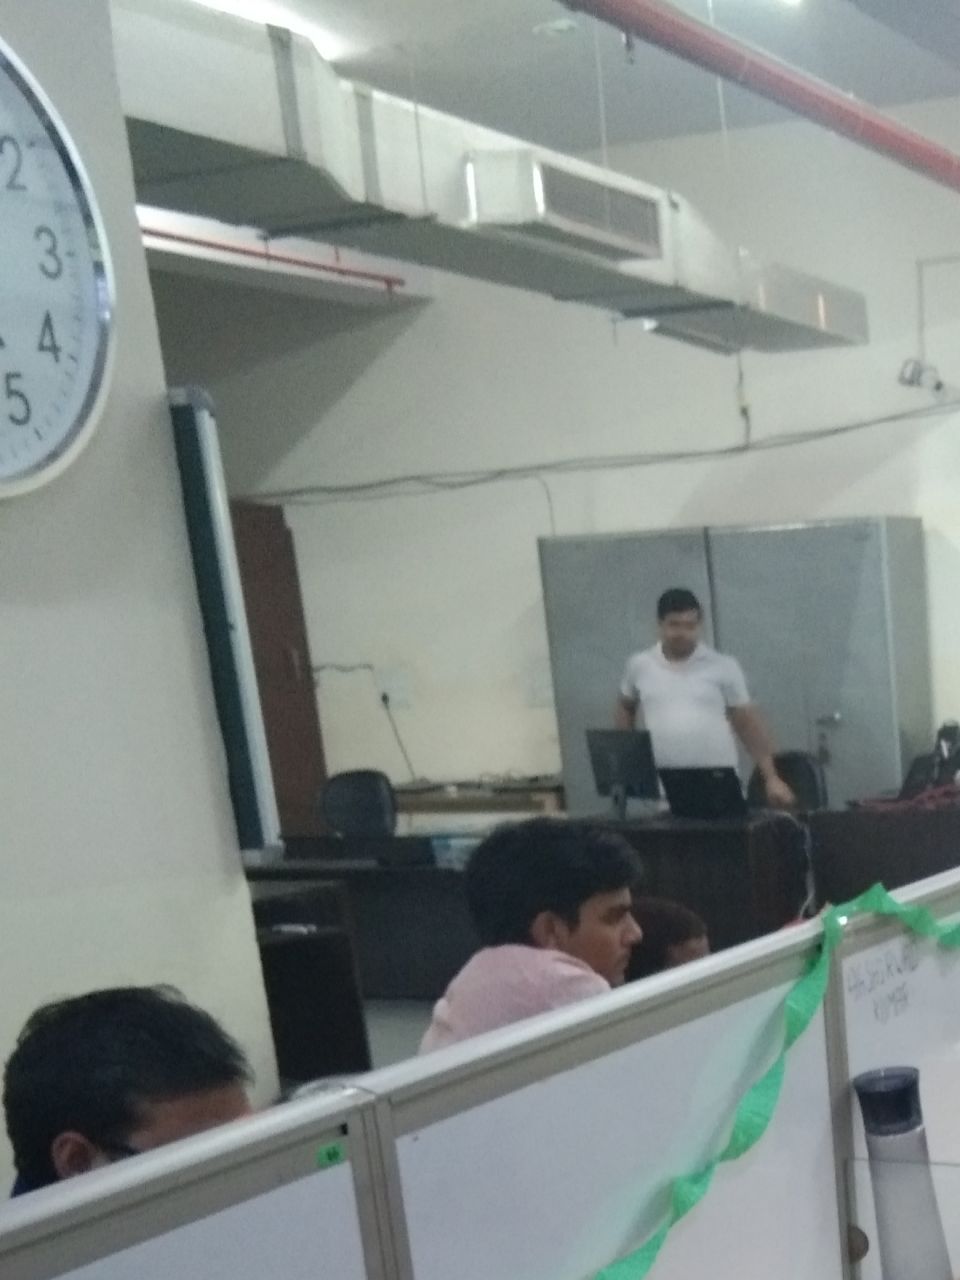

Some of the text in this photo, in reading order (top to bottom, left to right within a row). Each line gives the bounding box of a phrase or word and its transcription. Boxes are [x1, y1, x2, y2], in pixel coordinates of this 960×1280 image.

[33, 225, 63, 280] 3
[37, 310, 62, 363] 4
[5, 371, 32, 427] 5
